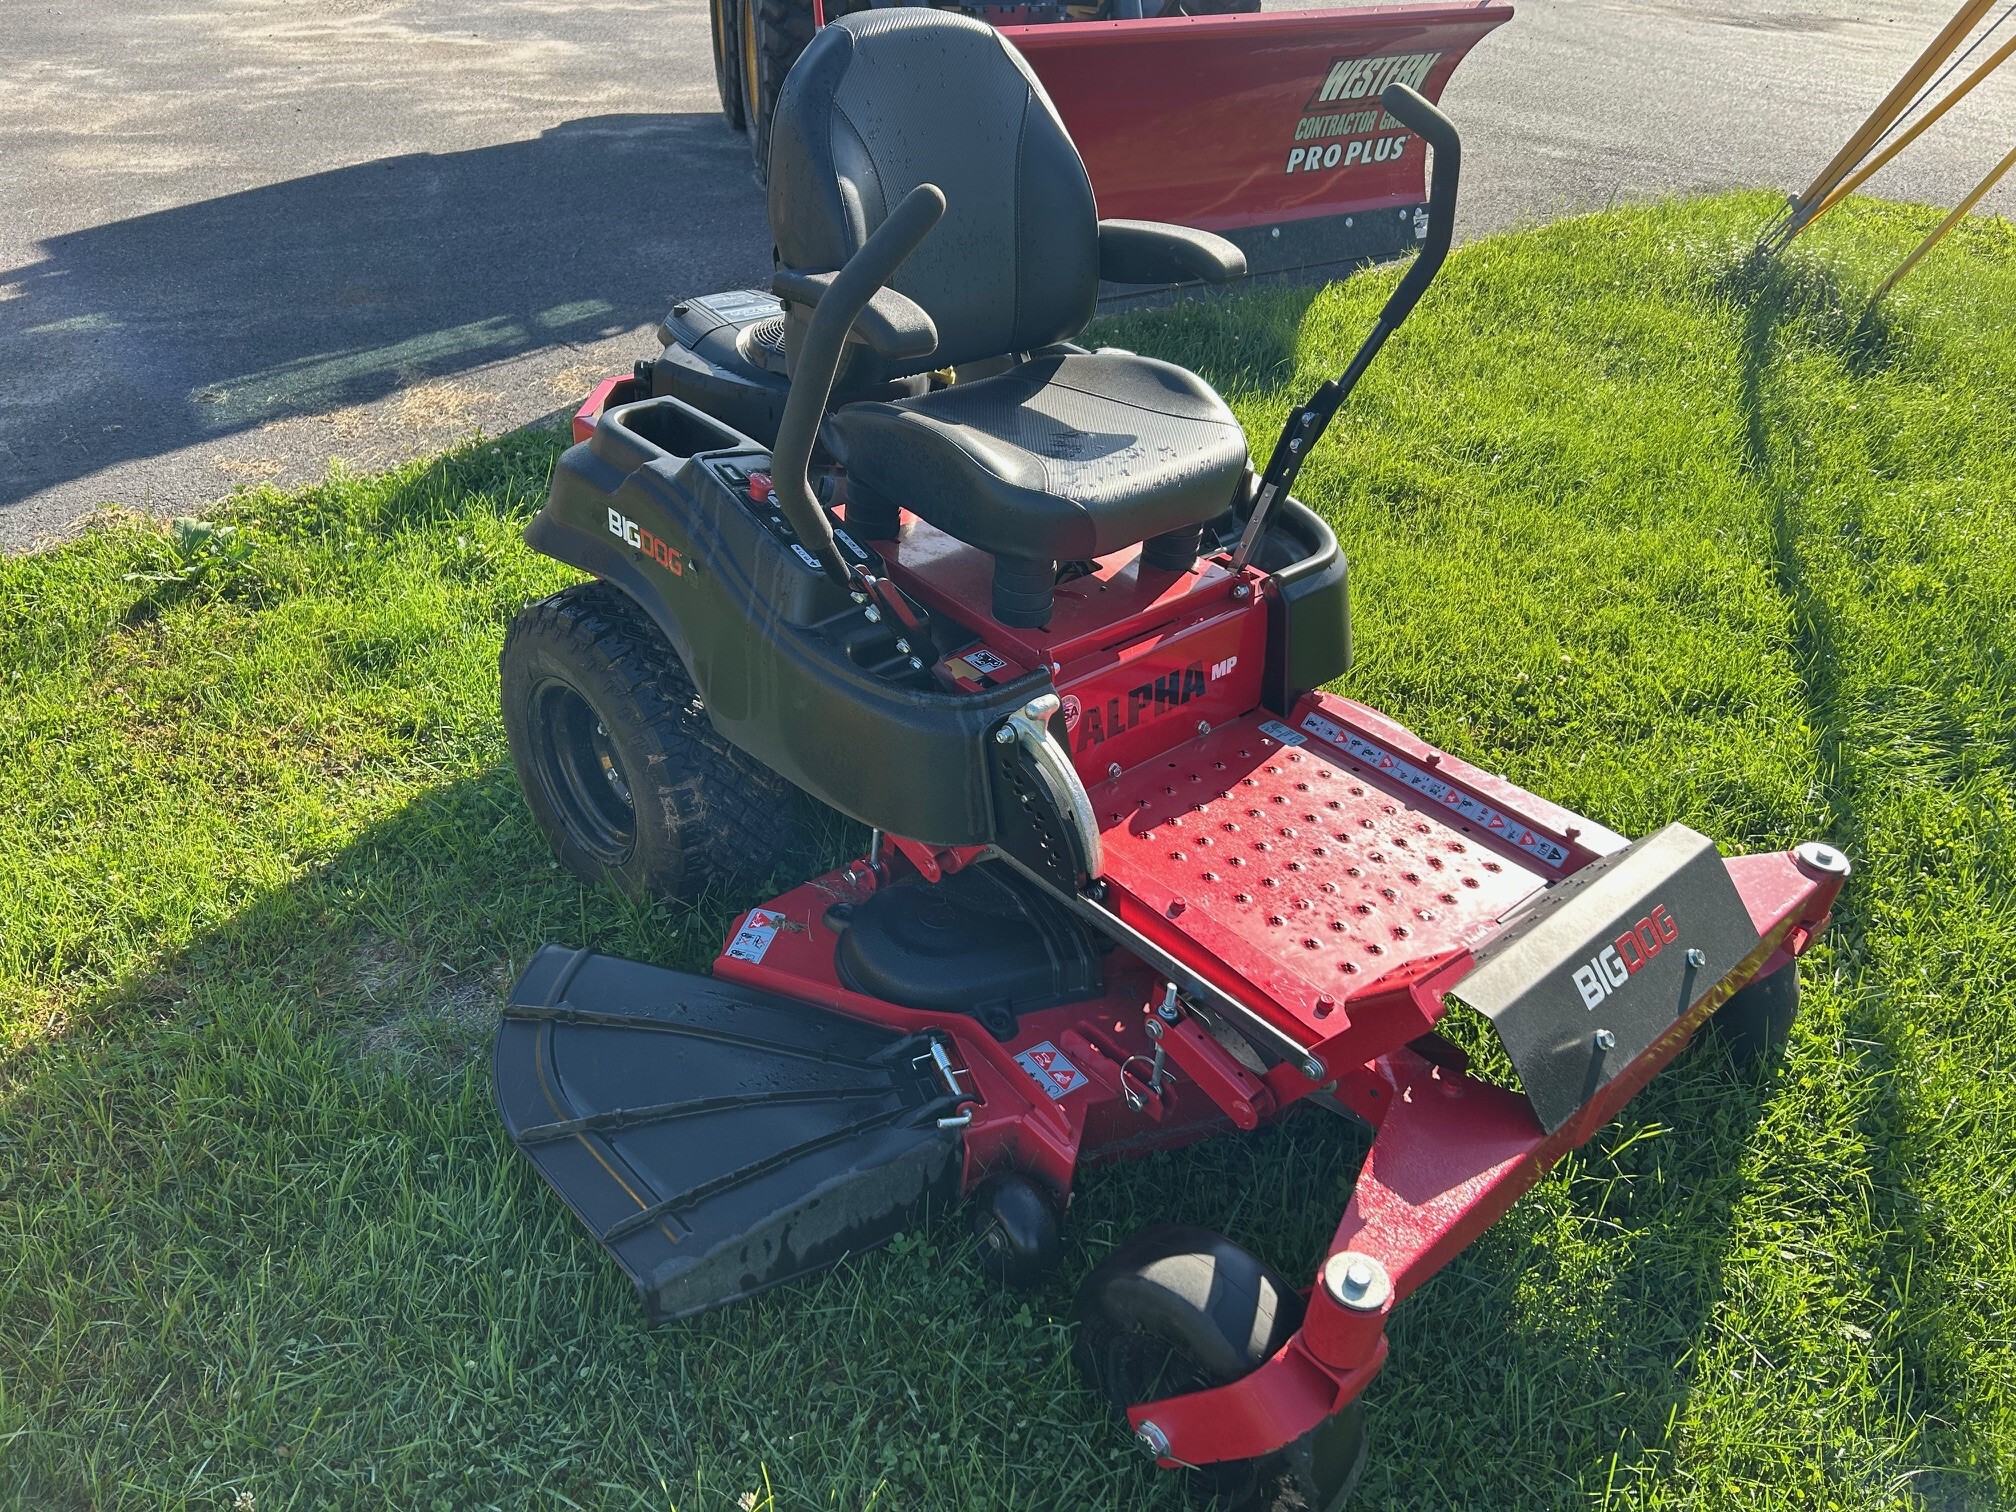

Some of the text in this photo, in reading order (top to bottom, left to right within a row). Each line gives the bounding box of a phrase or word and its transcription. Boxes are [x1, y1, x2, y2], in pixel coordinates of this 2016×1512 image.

[1319, 52, 1442, 102] WESTERN
[1294, 110, 1379, 140] CONTRACTOR
[1285, 136, 1406, 173] PRO PLUS
[1077, 660, 1207, 753] ALPHA
[1211, 656, 1238, 681] MP
